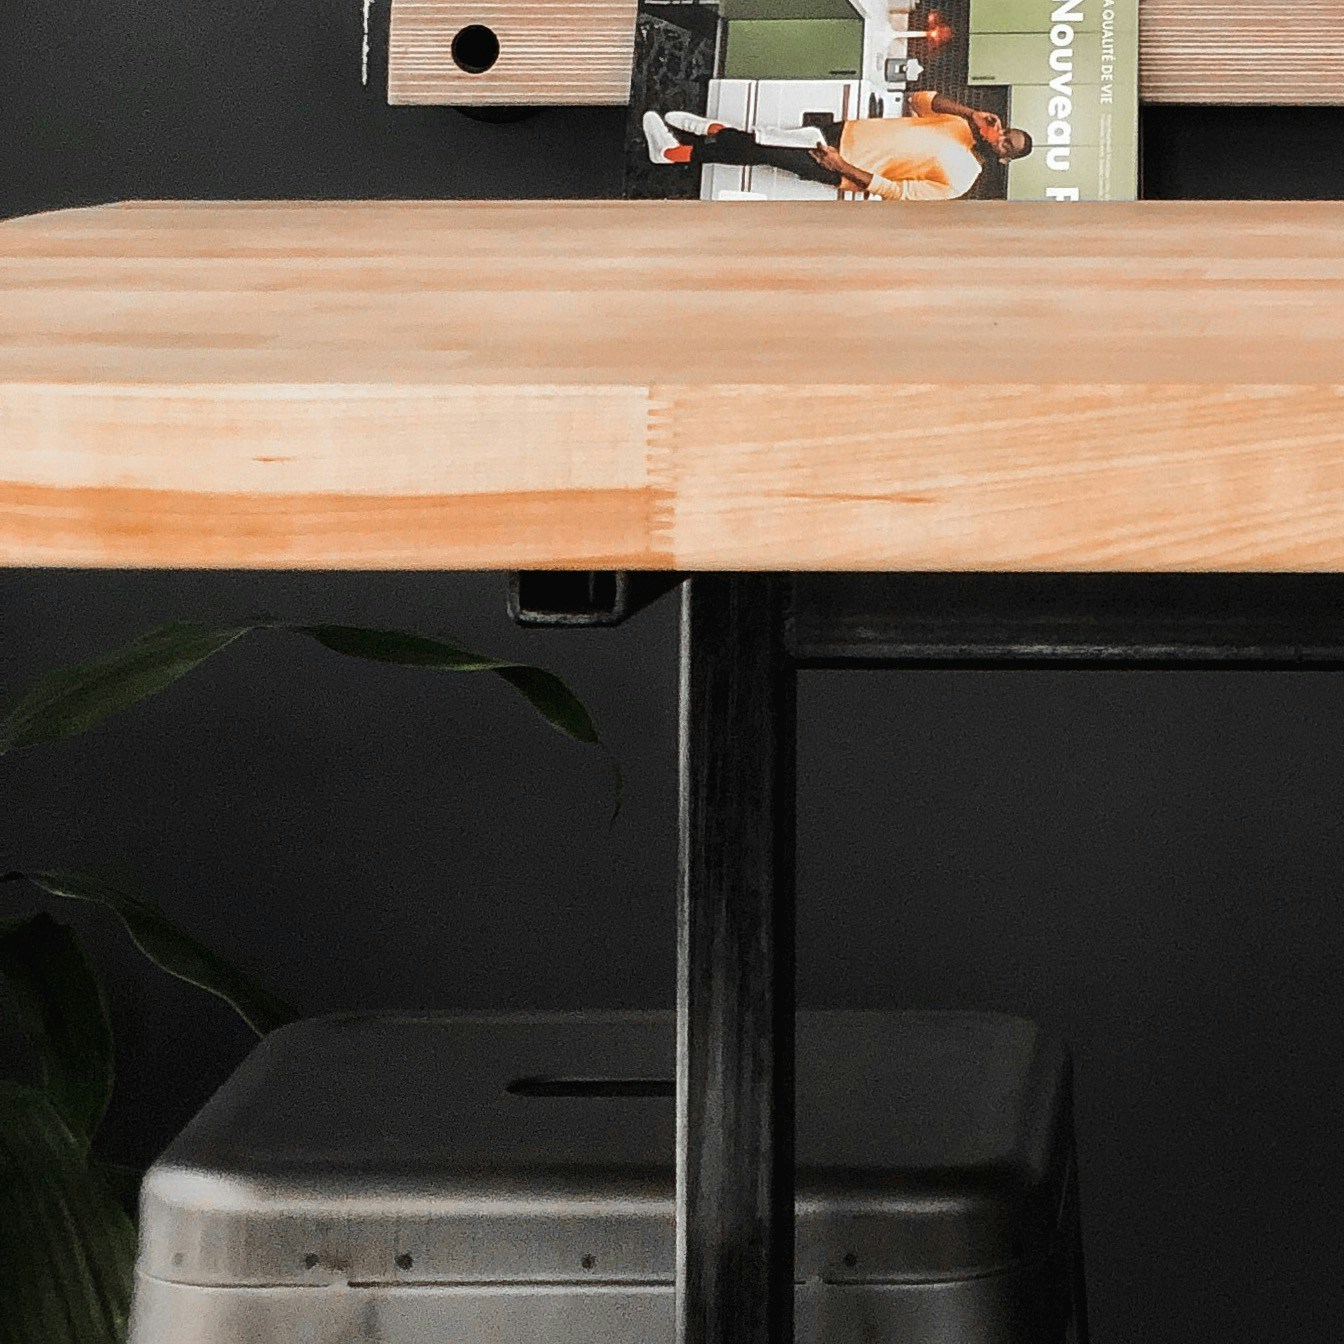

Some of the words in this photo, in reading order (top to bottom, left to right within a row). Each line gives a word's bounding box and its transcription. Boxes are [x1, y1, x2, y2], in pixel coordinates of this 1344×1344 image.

[1101, 10, 1116, 62] QUALITÉ
[1100, 65, 1113, 81] DE
[1100, 84, 1113, 104] VIE
